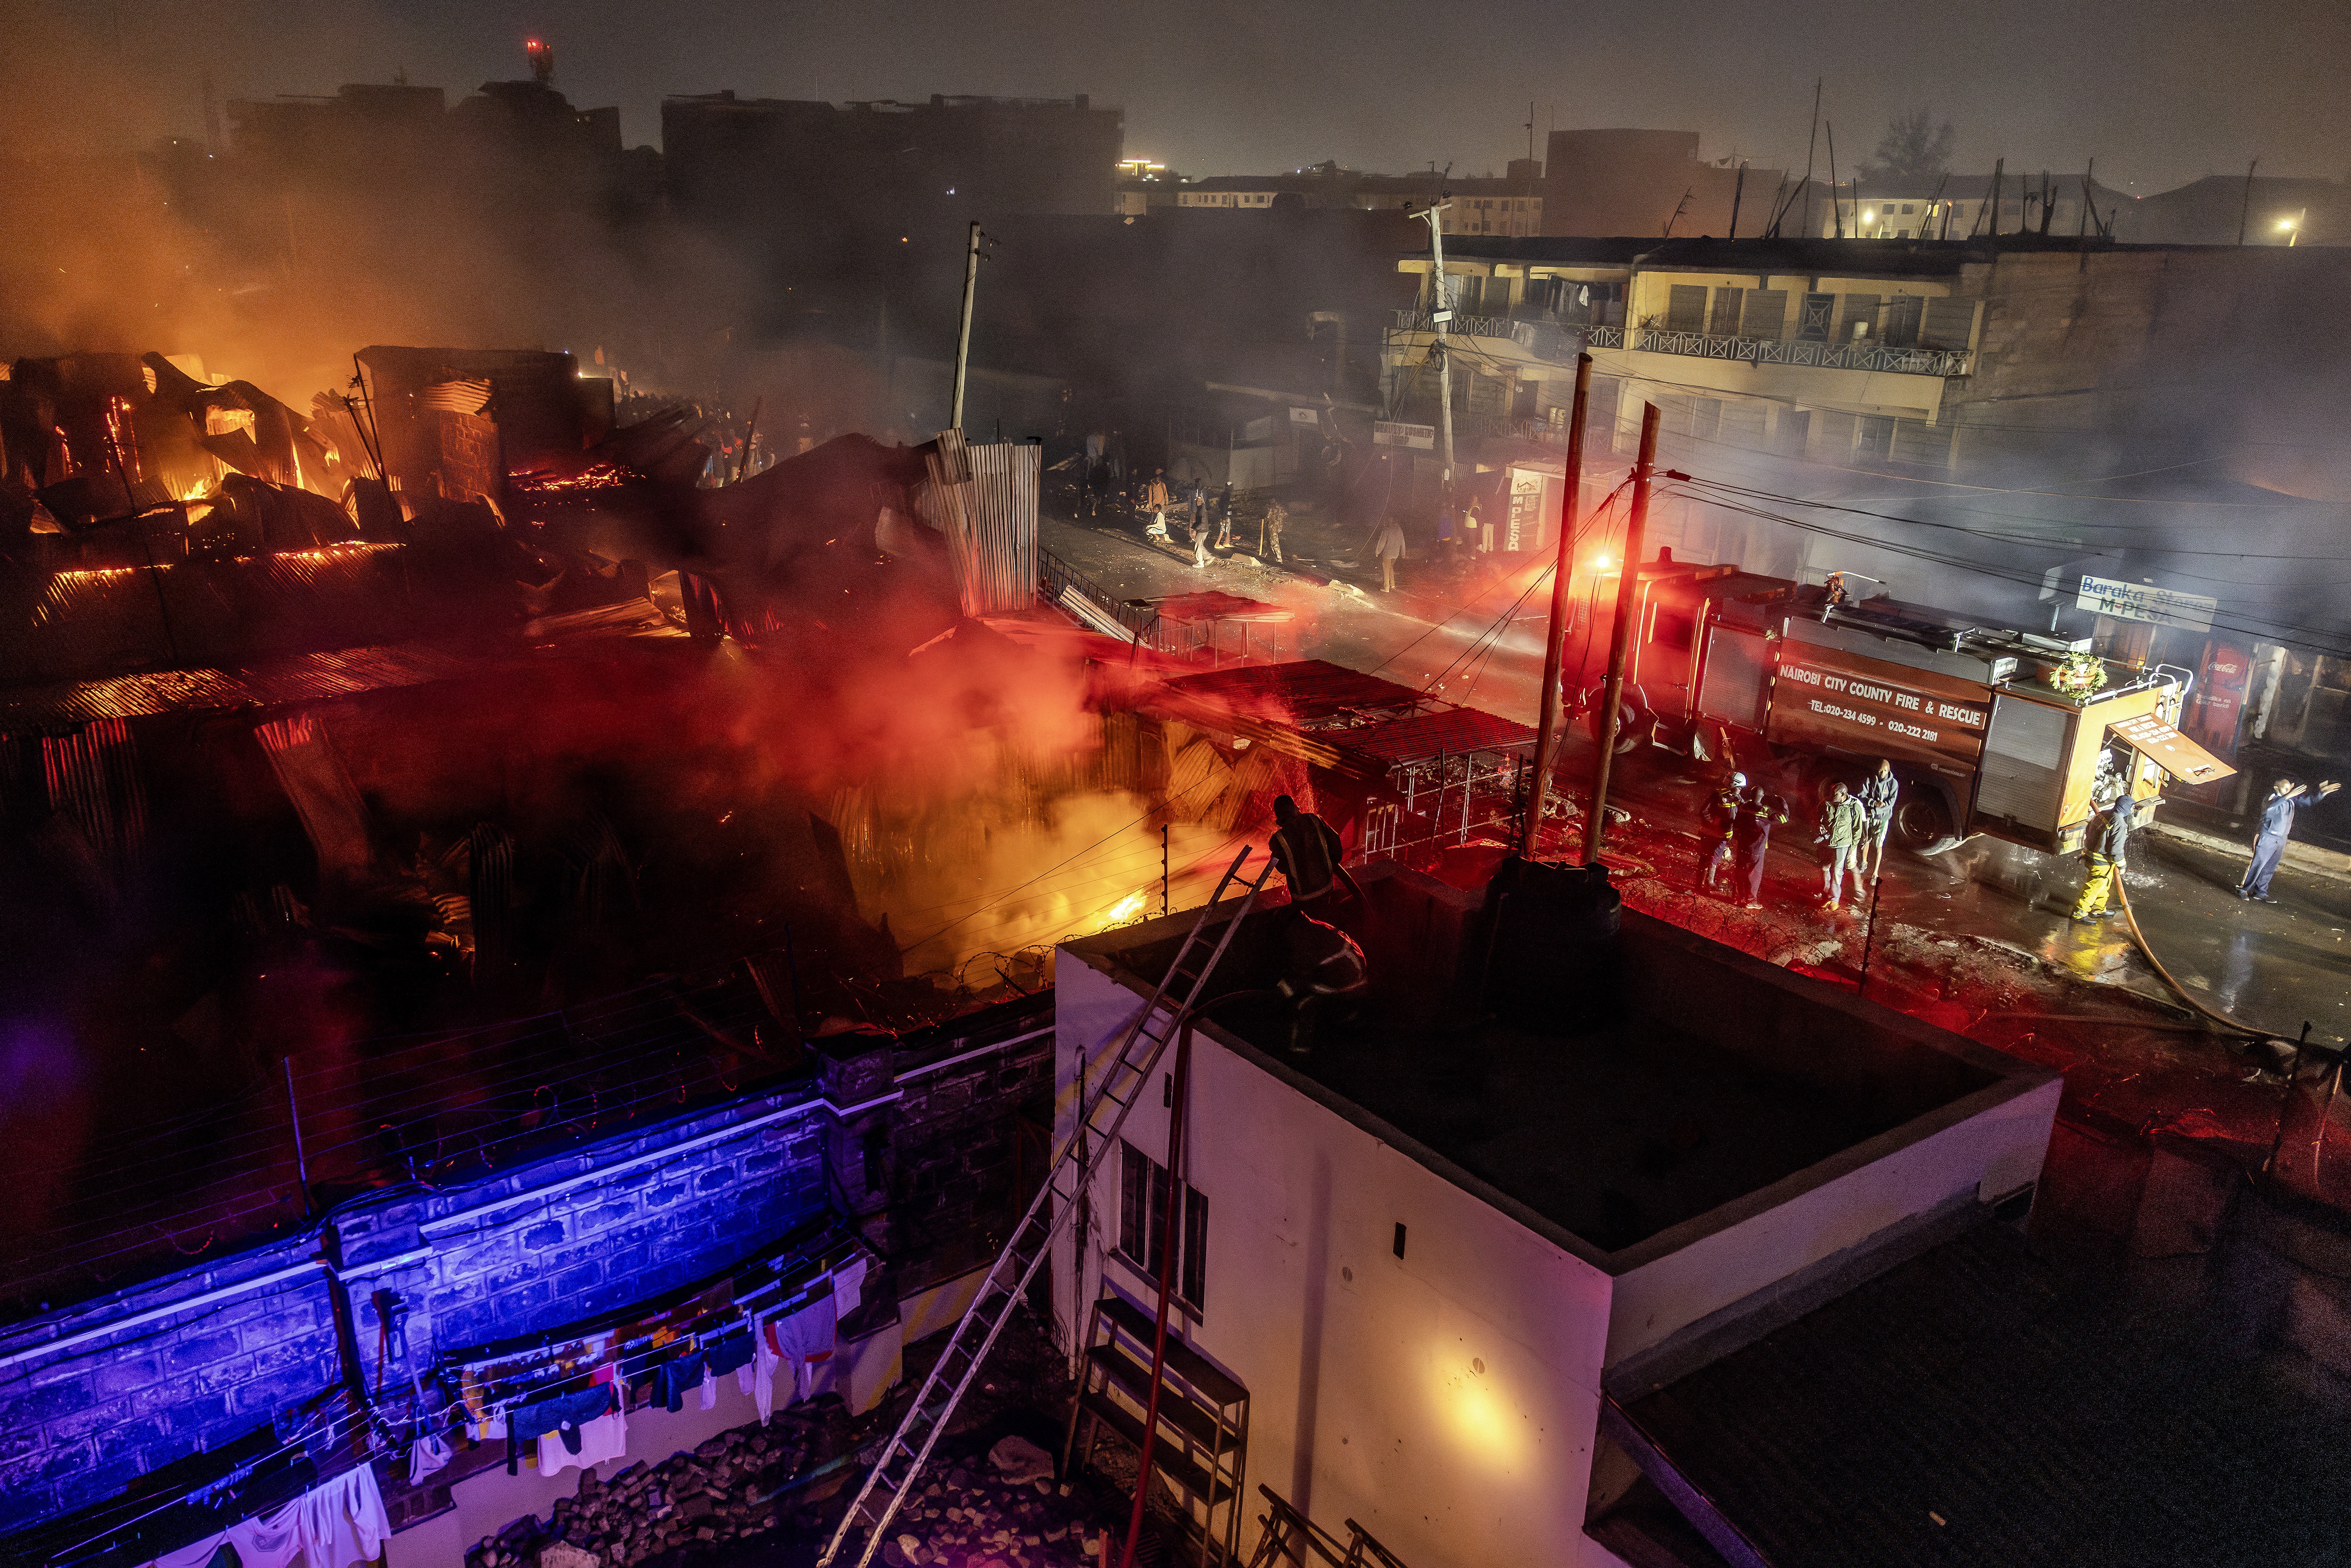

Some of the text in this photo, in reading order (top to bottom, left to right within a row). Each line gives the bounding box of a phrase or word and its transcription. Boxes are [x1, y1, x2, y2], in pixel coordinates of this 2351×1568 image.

[2082, 577, 2144, 603] Baraka
[2099, 597, 2172, 623] M-PESA
[1780, 665, 1980, 725] NAIROBI CITY COUNTY FIRE & RESCUE
[1811, 700, 1856, 720] TEL:020-234
[1857, 713, 1876, 725] 4599
[1888, 720, 1920, 738] 020-222
[1922, 729, 1938, 742] 2181
